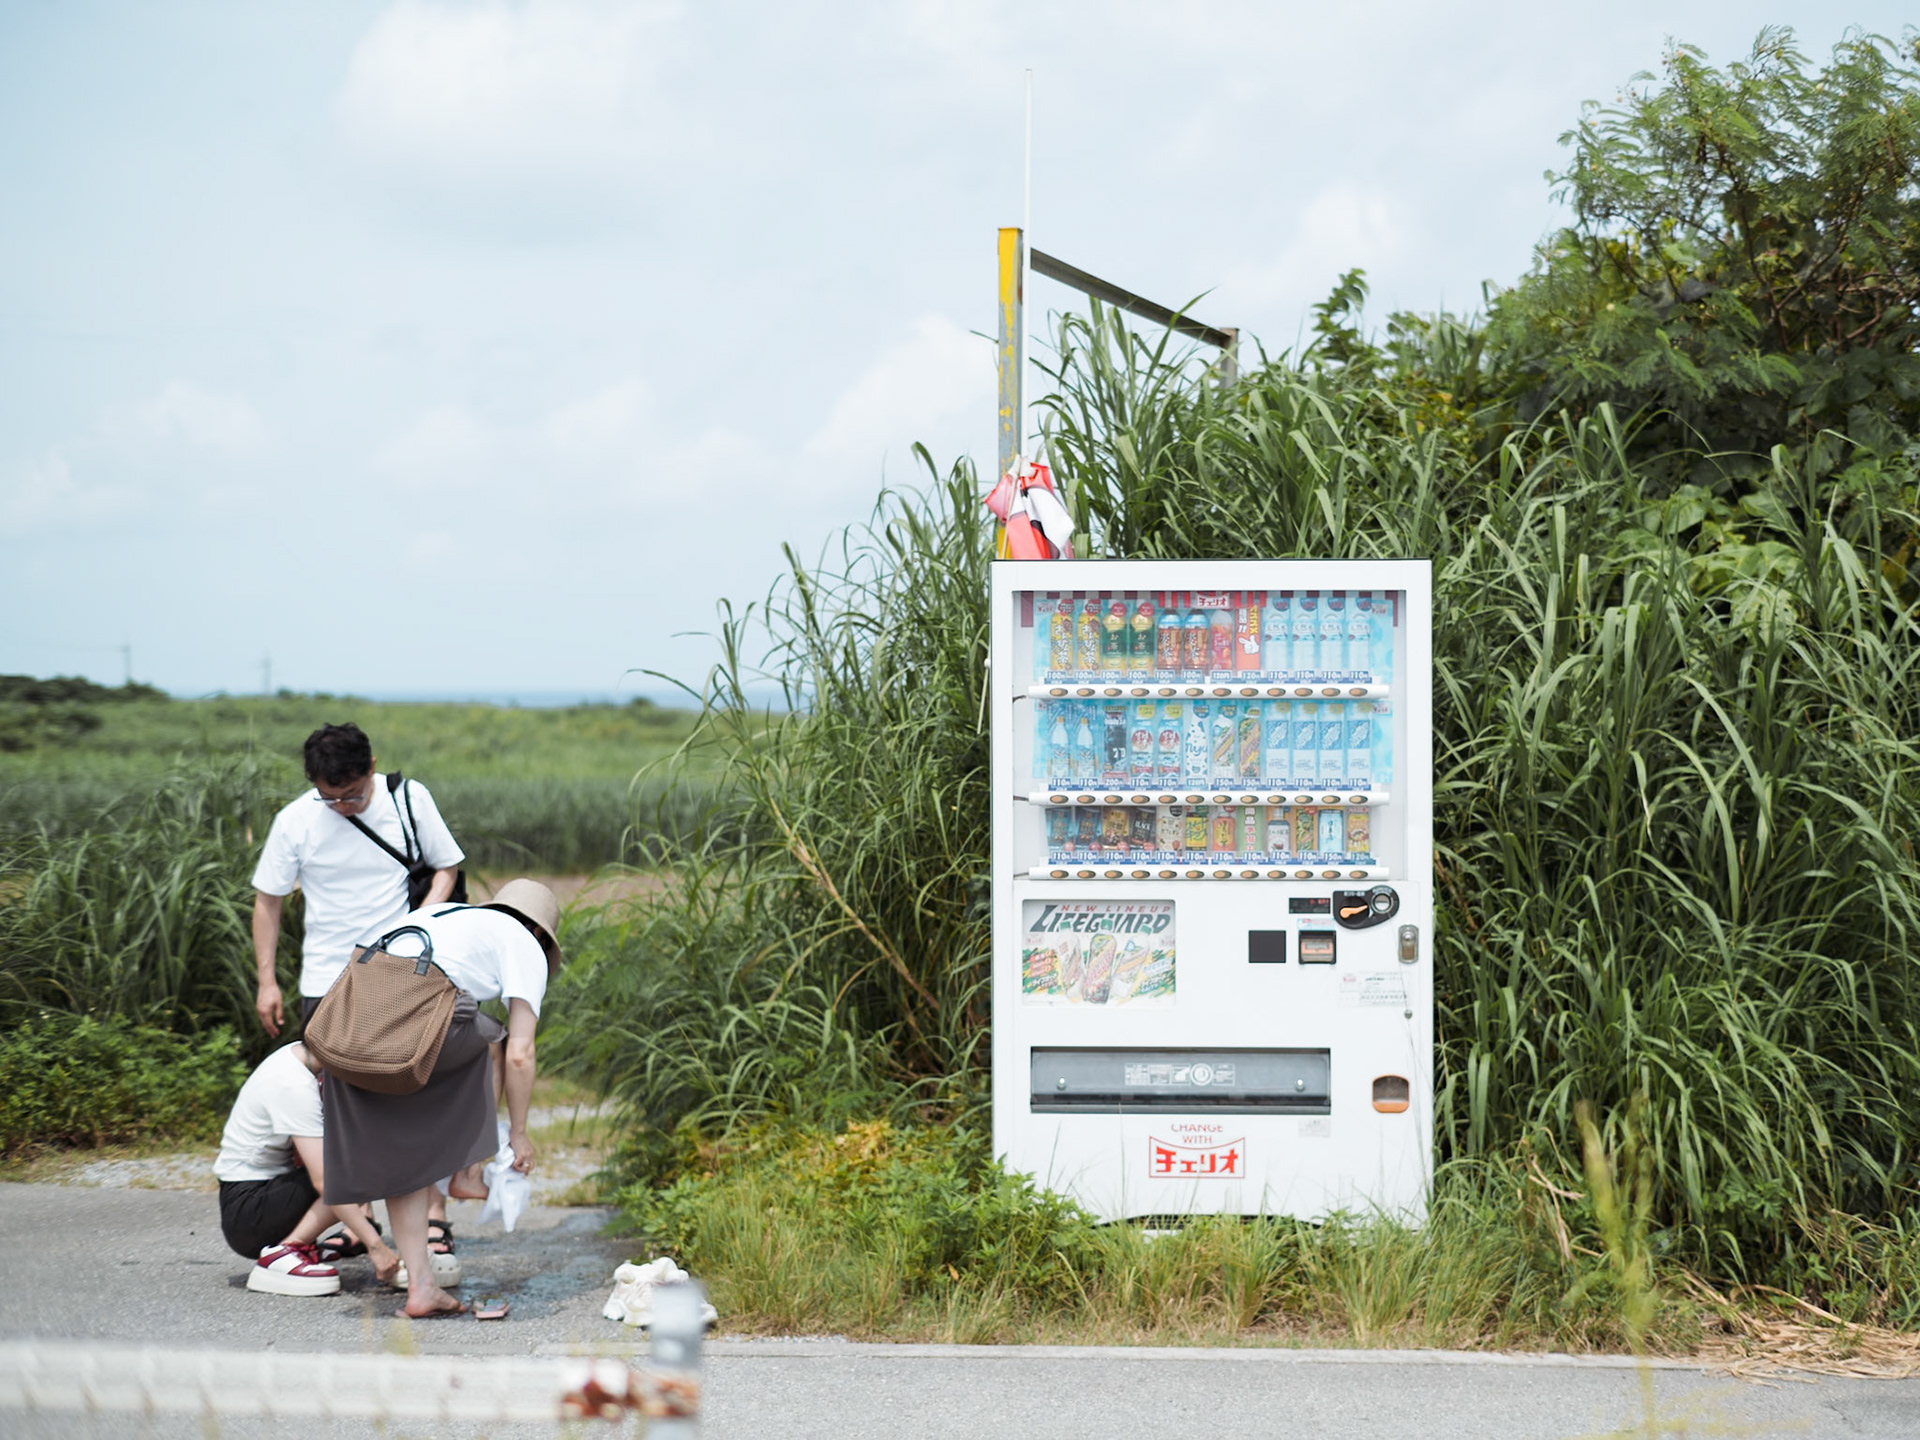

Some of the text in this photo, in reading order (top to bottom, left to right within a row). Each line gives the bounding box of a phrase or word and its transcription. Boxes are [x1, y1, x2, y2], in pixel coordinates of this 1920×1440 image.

[1198, 596, 1227, 606] チェリオ
[1135, 820, 1151, 831] BLACK
[1171, 1124, 1223, 1133] CHANGE
[1182, 1135, 1212, 1144] WITH
[1155, 1146, 1238, 1174] チェリオ
